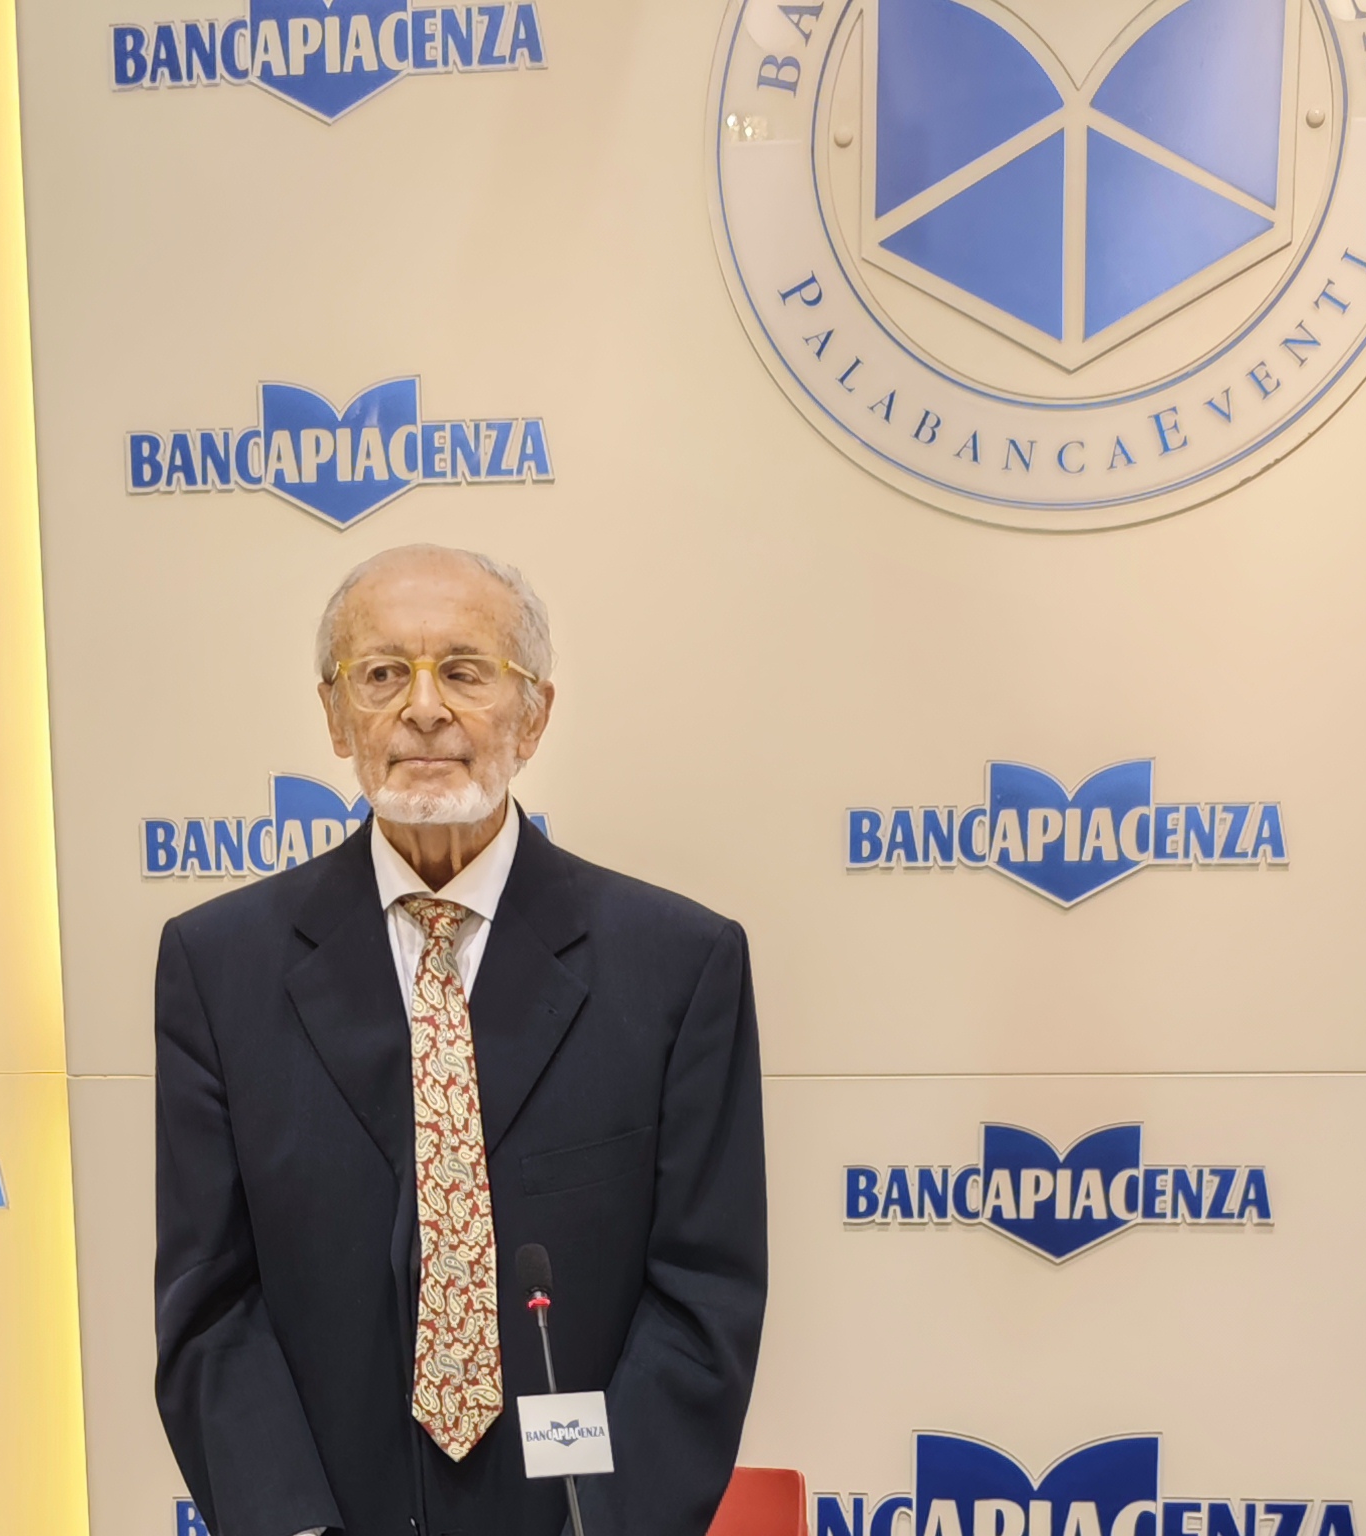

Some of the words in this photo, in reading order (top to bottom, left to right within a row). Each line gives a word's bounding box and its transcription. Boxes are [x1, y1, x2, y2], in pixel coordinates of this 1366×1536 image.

[112, 3, 545, 87] BANCAPIACENZA
[129, 420, 550, 488] BANCAPIACENZA
[848, 804, 1286, 864] BANCAPIACENZA
[846, 1168, 1272, 1220] BANCAPIACENZA
[526, 1426, 605, 1442] BANCAPIACENZA
